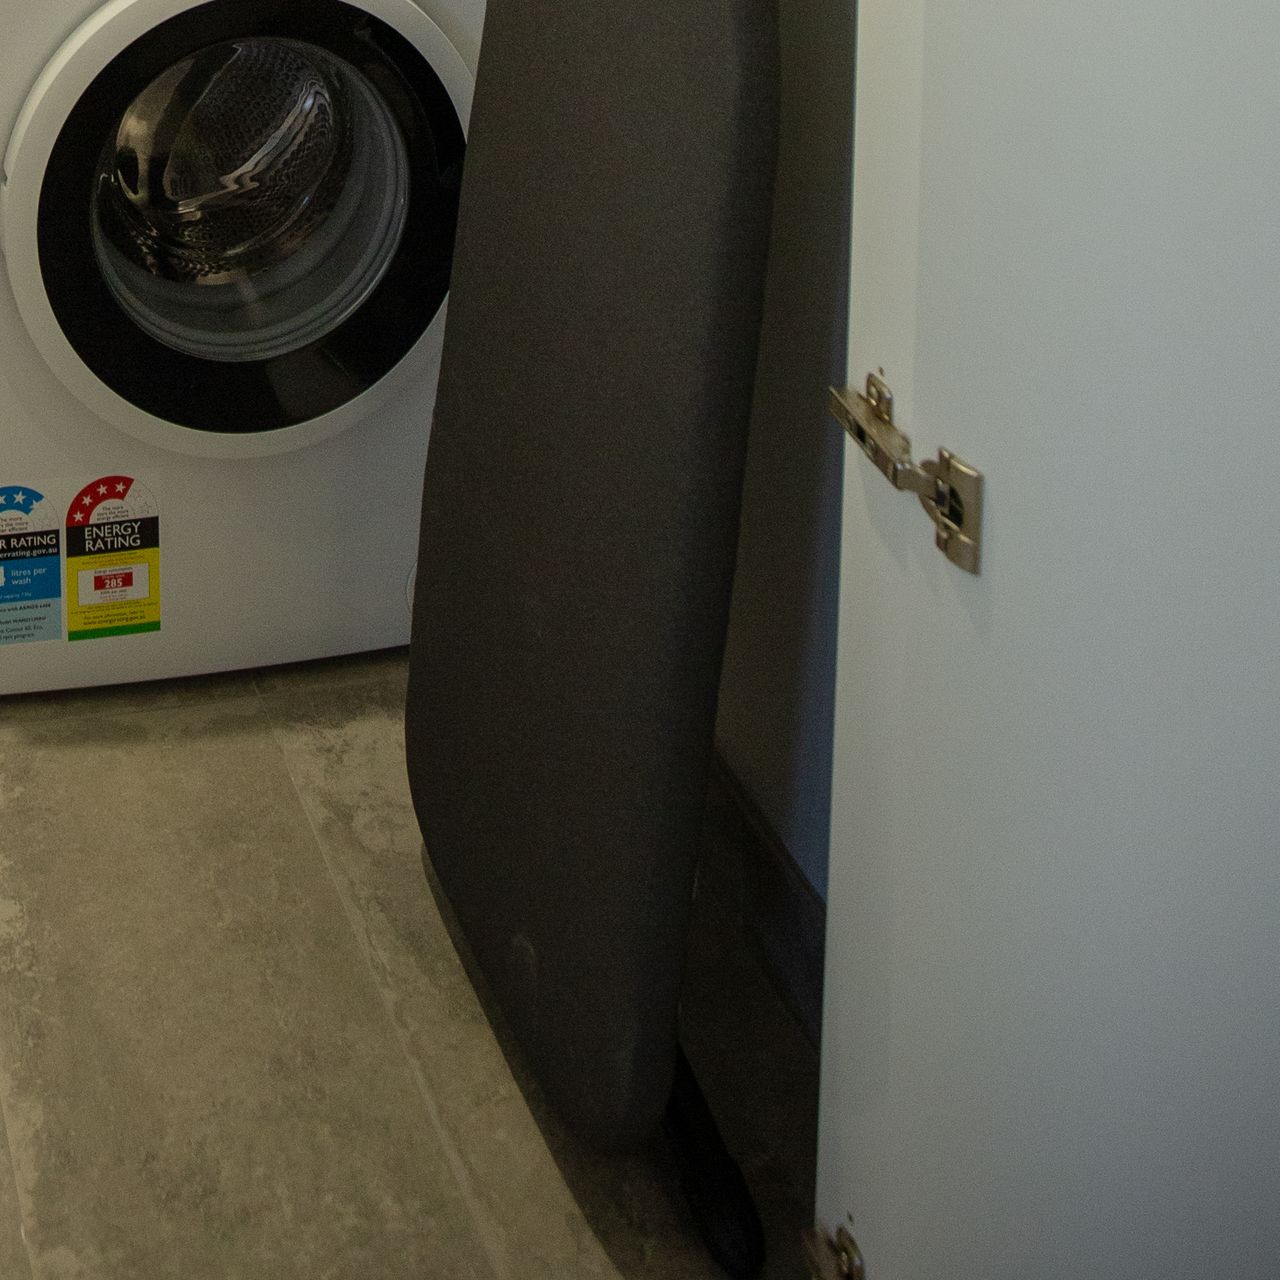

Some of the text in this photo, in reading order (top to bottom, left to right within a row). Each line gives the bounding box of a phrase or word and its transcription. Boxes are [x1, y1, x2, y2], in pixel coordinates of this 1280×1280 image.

[84, 521, 141, 539] ENERGY
[10, 534, 56, 549] RATING
[85, 534, 141, 552] RATING
[11, 567, 47, 577] litres per
[11, 577, 32, 585] wash
[104, 578, 123, 588] 285
